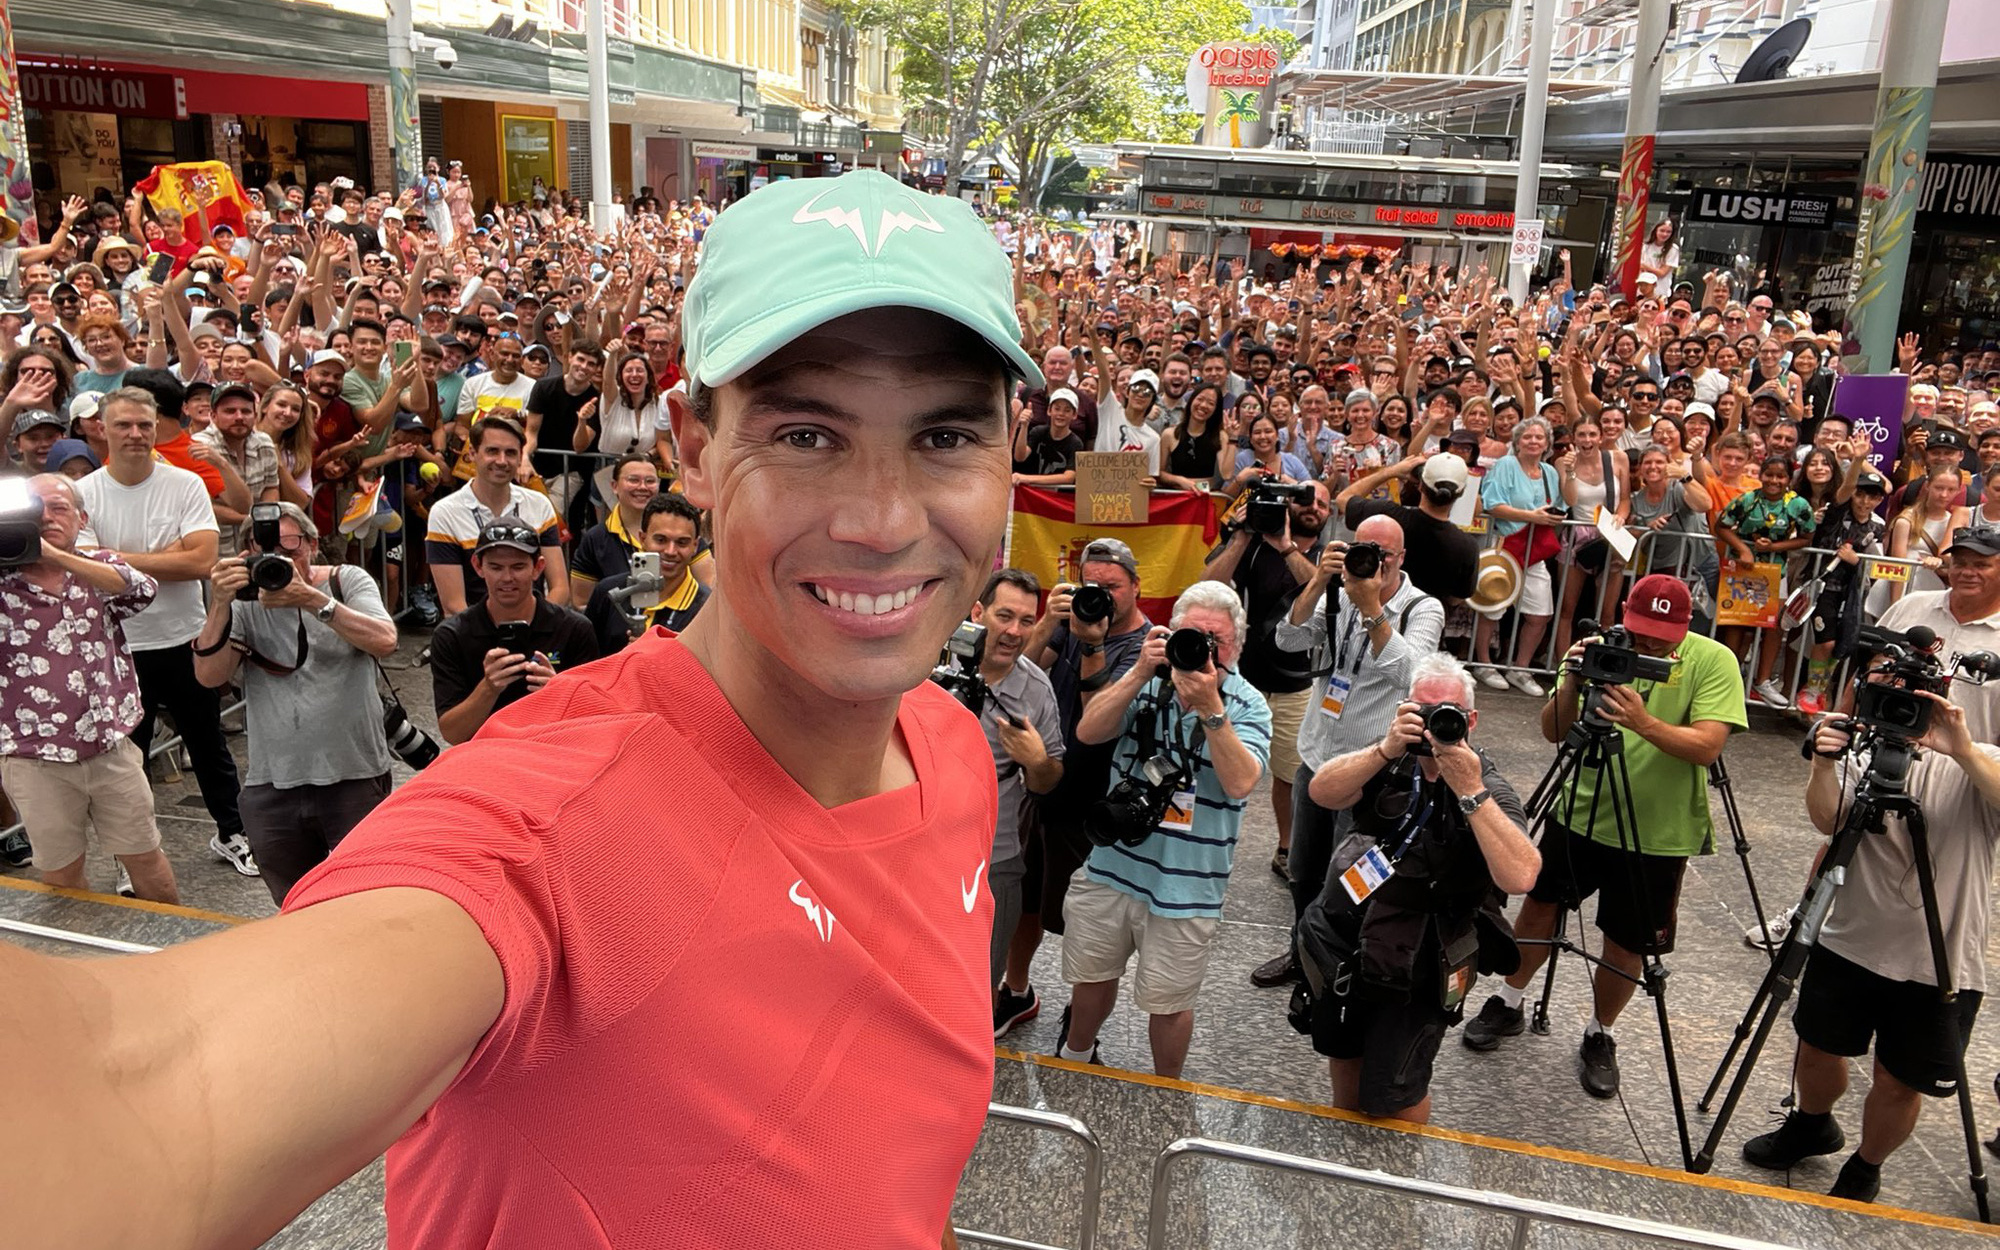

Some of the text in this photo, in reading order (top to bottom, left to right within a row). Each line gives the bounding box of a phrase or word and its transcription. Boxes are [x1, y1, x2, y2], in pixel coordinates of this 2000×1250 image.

[22, 72, 146, 109] OTTON ON
[776, 153, 798, 161] rebel
[1302, 204, 1357, 221] shakes
[1375, 206, 1439, 225] fruit salad
[1701, 194, 1828, 221] LUSH FRESH
[1455, 211, 1515, 228] smoothi
[1848, 208, 1872, 303] BRISBANE
[1816, 263, 1843, 281] OUT
[1077, 454, 1147, 468] WELCOME BACK
[1091, 468, 1138, 480] ON TOUR
[1094, 480, 1129, 493] 2024
[1089, 493, 1131, 503] VAMOS
[1092, 503, 1133, 522] RAFA
[1876, 563, 1905, 577] TFH
